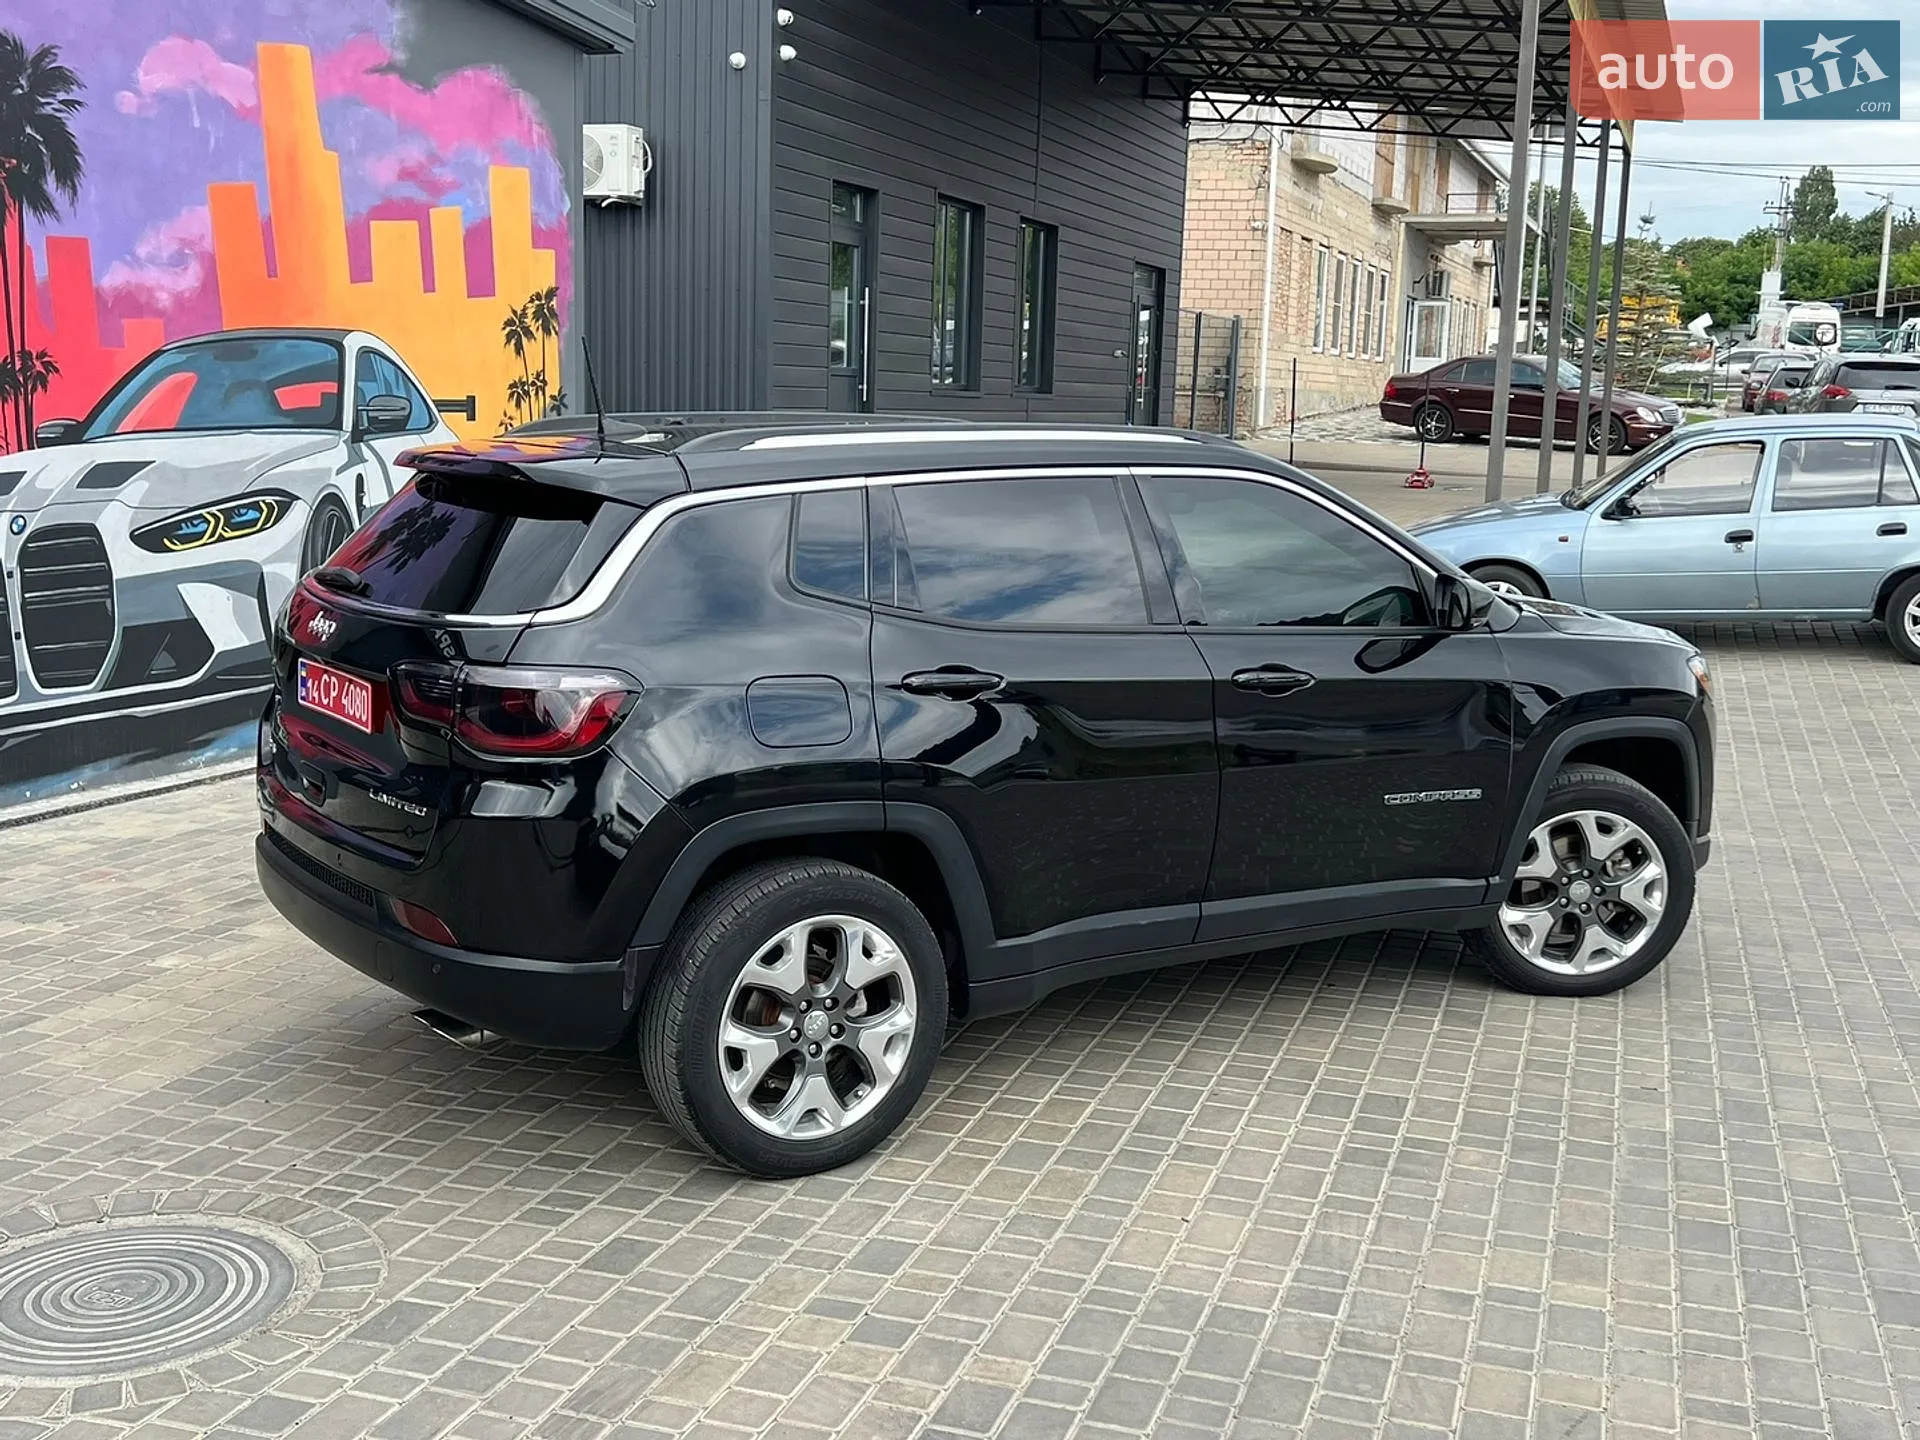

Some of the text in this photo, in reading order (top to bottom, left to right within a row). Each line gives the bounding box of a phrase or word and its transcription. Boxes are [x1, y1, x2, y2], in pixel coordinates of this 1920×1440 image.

[341, 681, 368, 722] 4080
[369, 788, 427, 816] LIMITED
[1384, 788, 1482, 805] COMPASS
